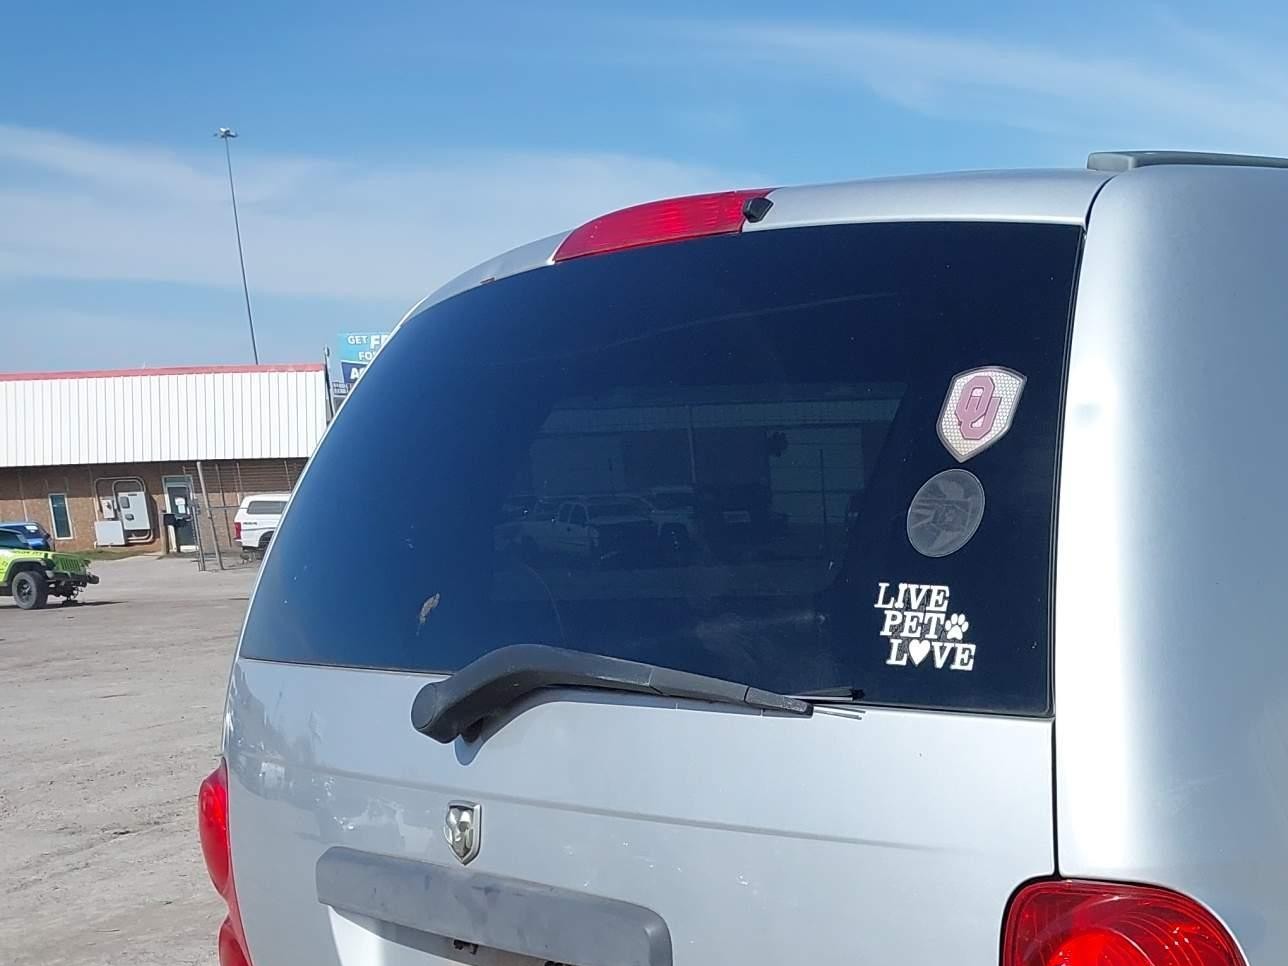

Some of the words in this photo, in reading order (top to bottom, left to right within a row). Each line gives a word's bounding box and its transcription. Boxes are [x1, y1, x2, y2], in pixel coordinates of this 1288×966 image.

[347, 335, 368, 344] GET
[873, 582, 950, 612] LIVE
[879, 609, 947, 639] PET
